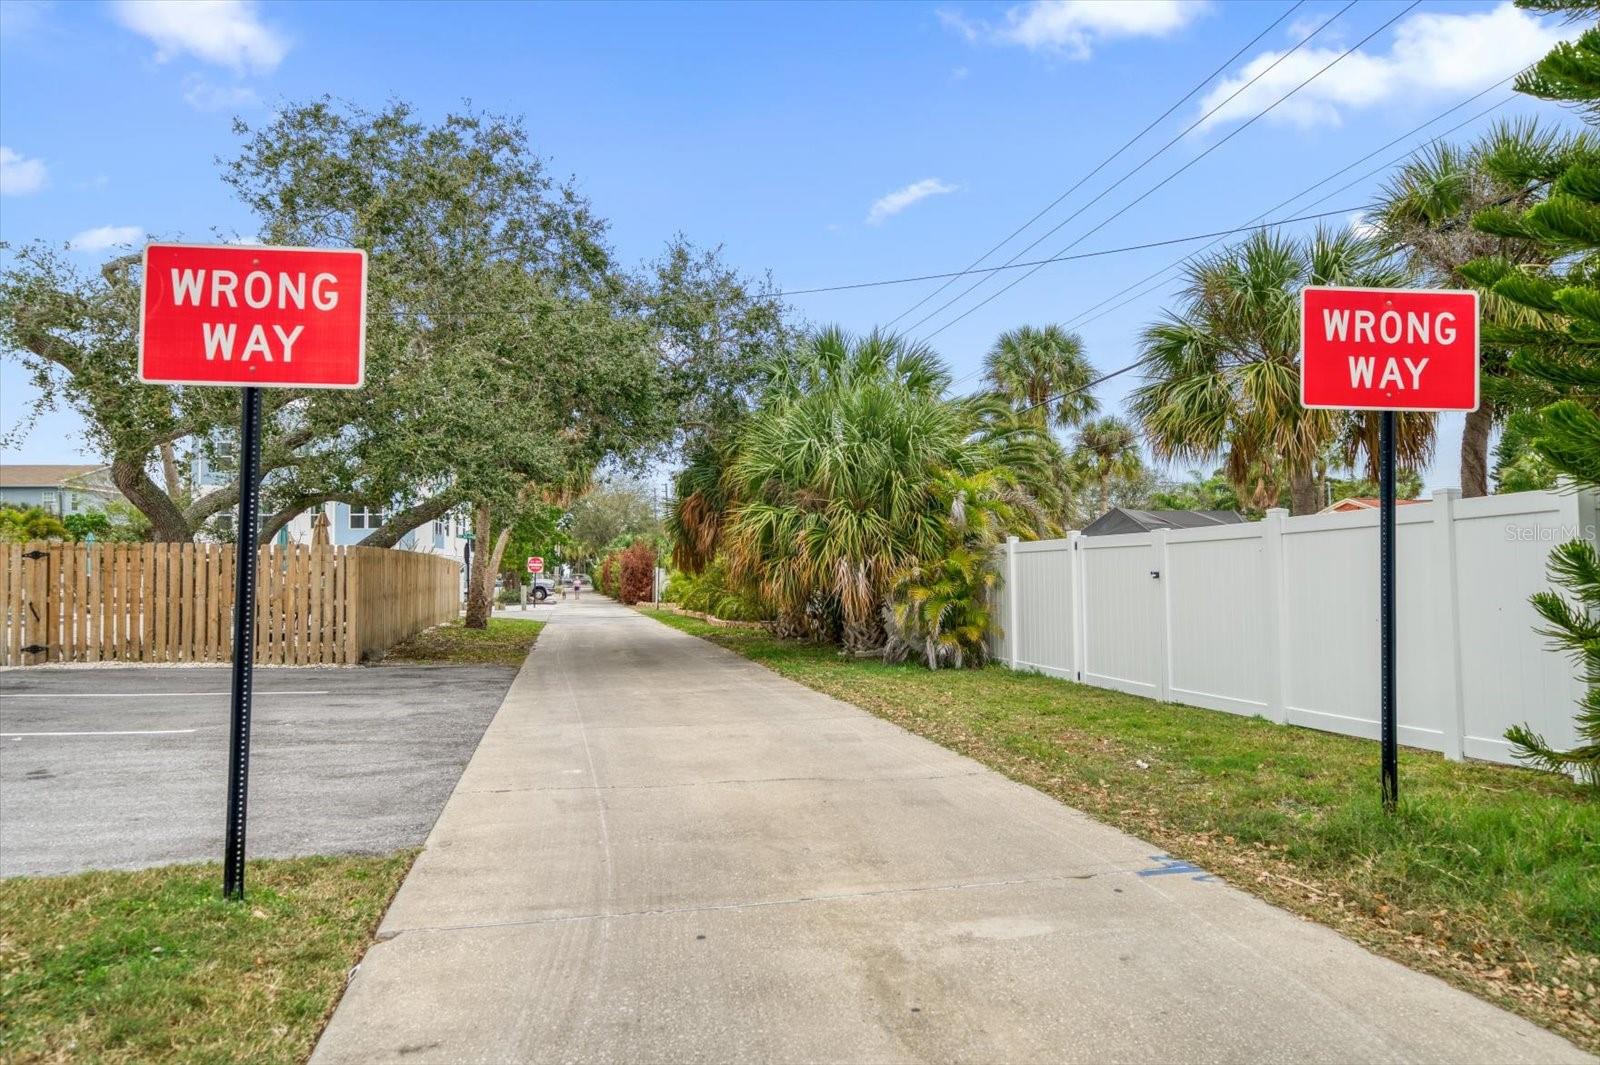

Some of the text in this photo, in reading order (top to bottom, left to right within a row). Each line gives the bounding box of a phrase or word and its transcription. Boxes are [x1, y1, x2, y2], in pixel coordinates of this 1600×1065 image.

[171, 268, 339, 311] WRONG
[203, 323, 305, 362] WAY
[1322, 309, 1457, 345] WRONG
[1348, 356, 1430, 390] WAY
